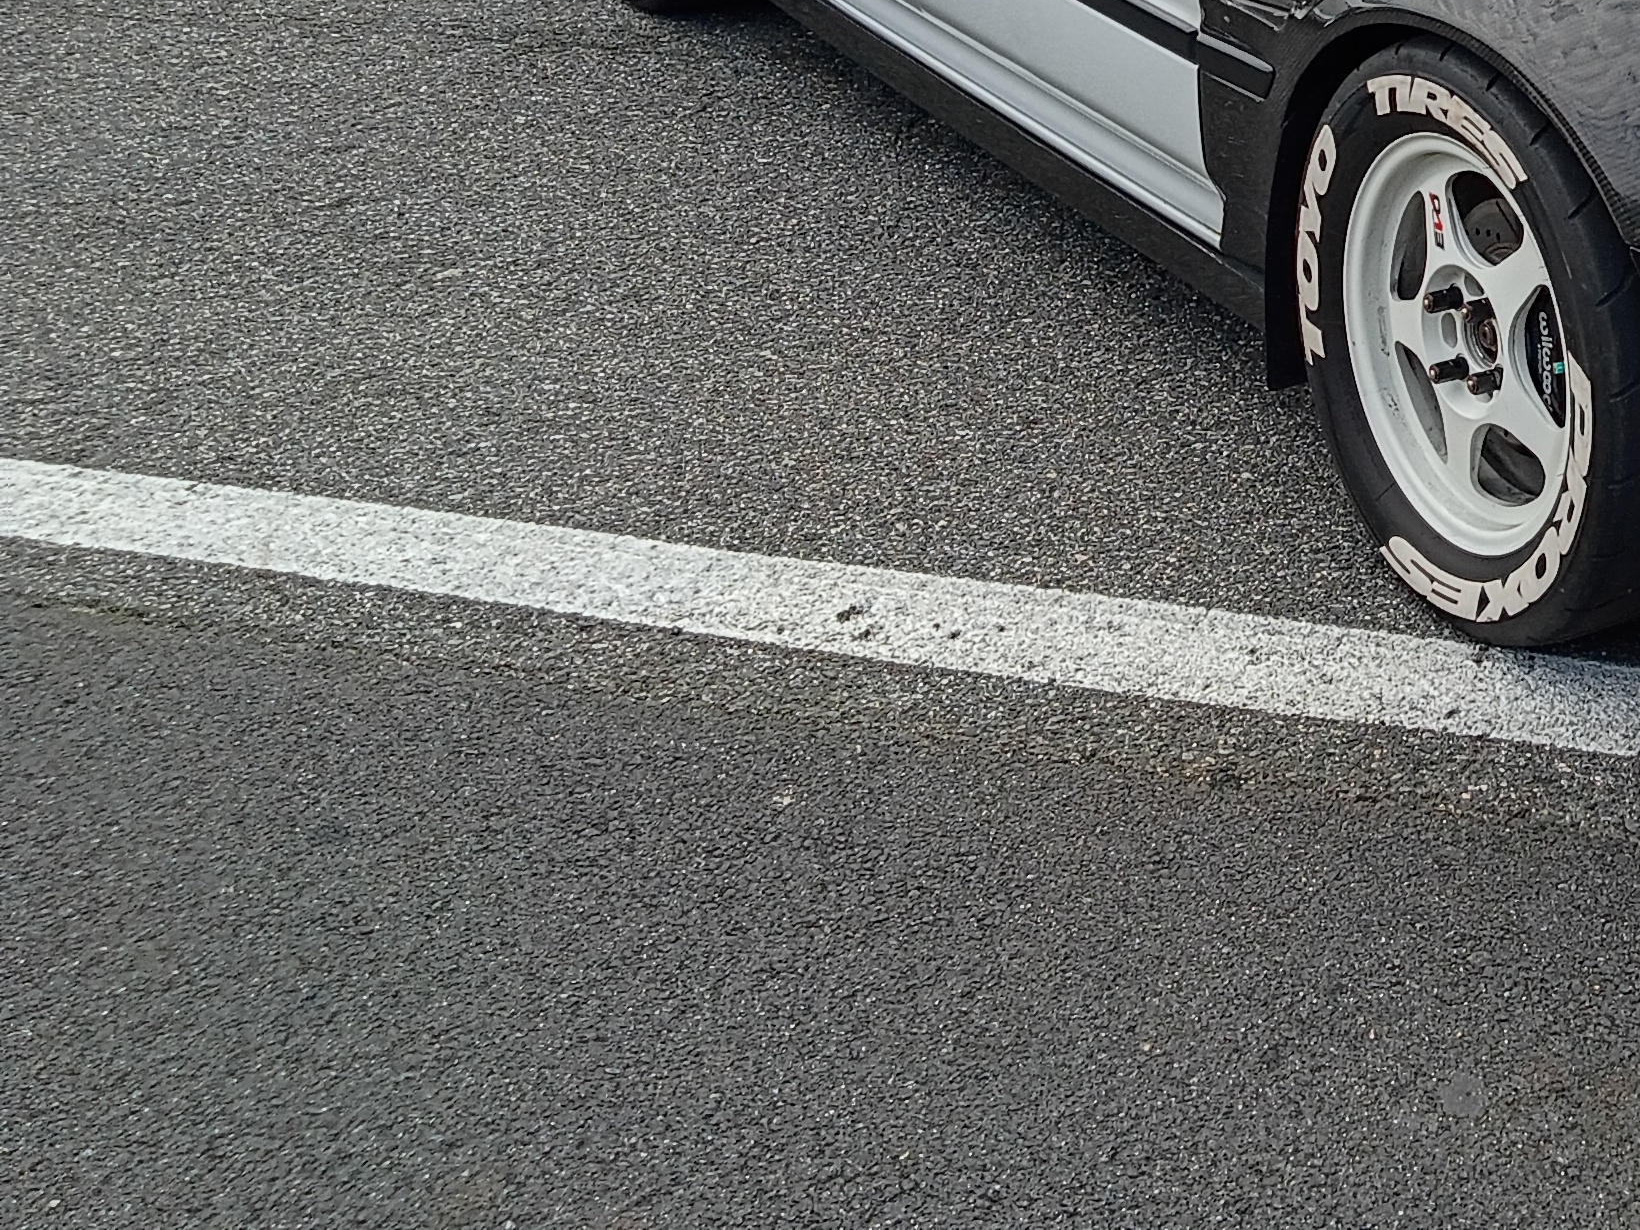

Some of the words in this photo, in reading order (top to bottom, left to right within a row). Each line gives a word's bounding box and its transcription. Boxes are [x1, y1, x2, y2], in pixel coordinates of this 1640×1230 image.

[1295, 124, 1337, 367] TOYO
[1366, 73, 1529, 191] TIRES
[1378, 349, 1593, 624] PROXES
